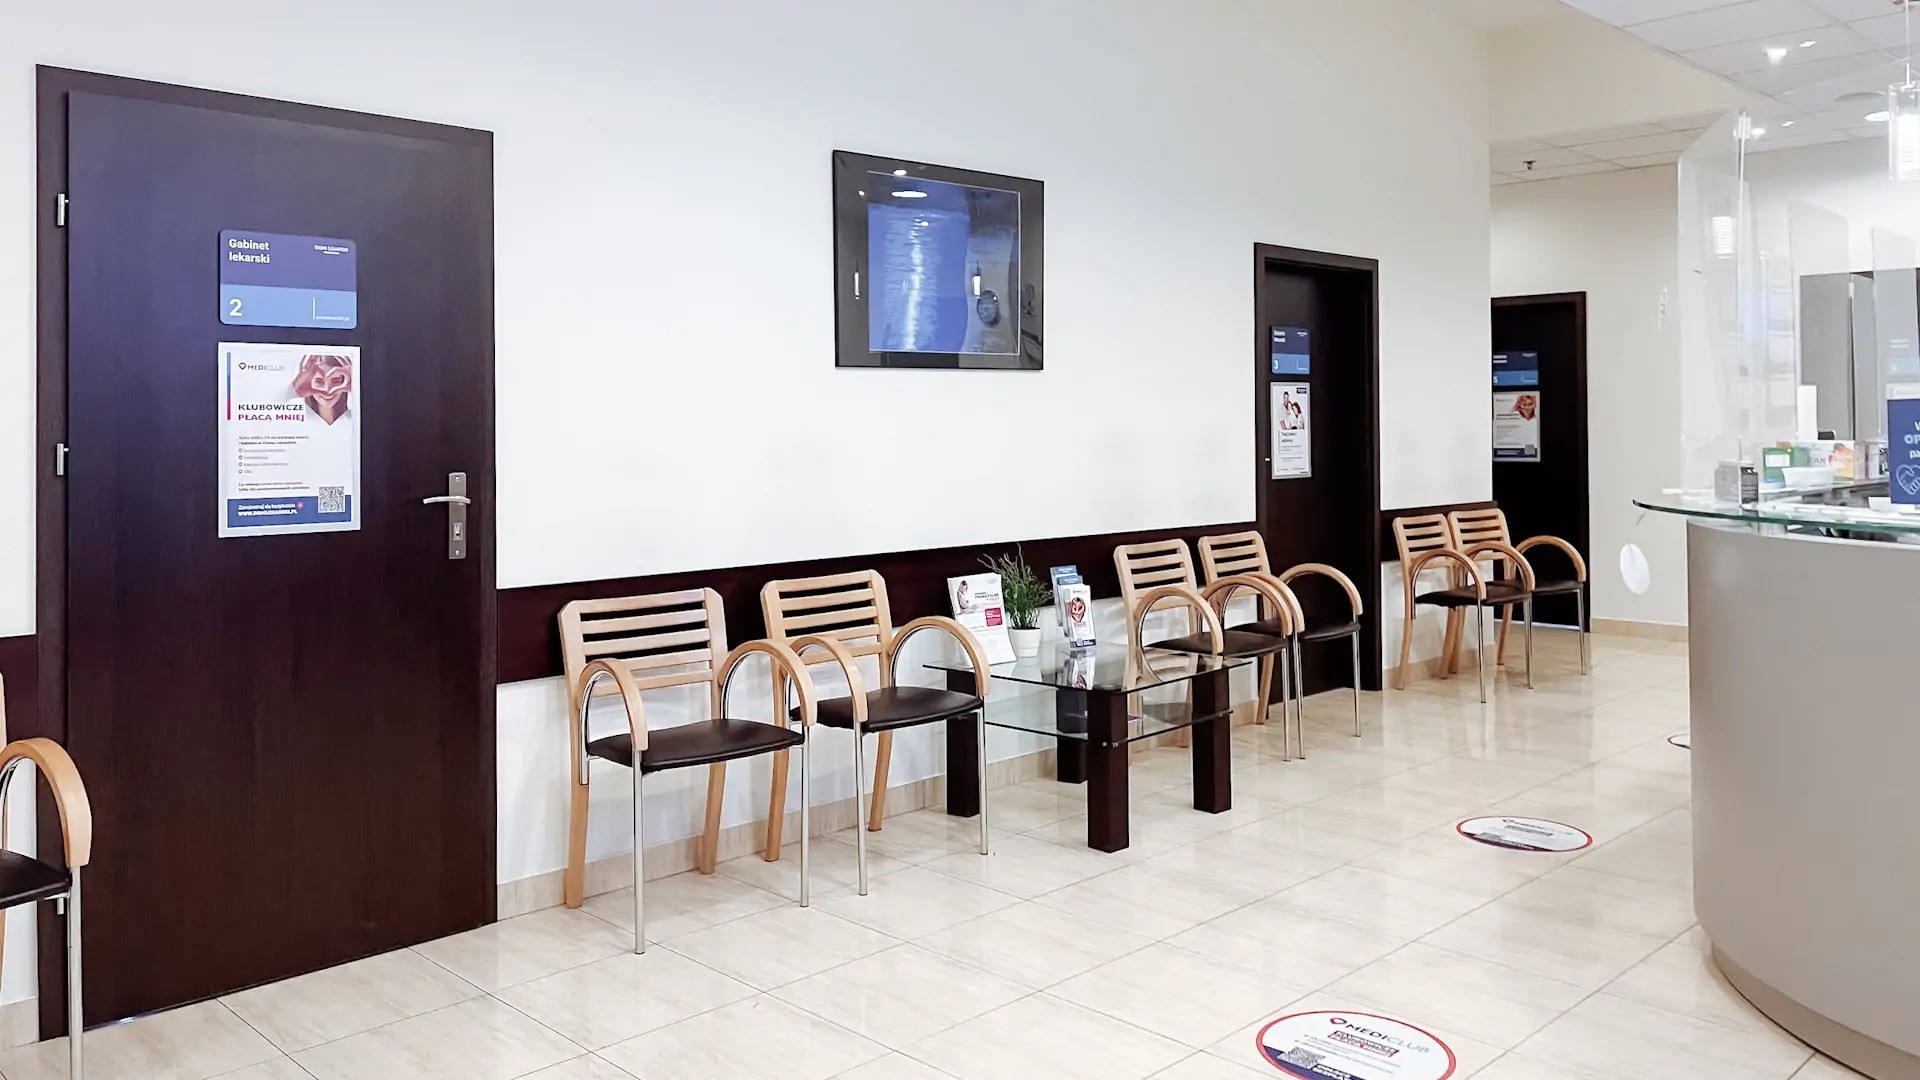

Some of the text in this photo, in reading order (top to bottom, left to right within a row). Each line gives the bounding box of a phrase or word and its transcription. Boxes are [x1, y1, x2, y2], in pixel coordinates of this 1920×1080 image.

[228, 238, 270, 251] Gabinet
[228, 251, 271, 264] lekarski
[229, 298, 243, 317] 2
[1273, 359, 1279, 370] 3
[238, 414, 305, 422] PŁACĄ MNIEJ
[1346, 1023, 1430, 1054] MEDICLUB
